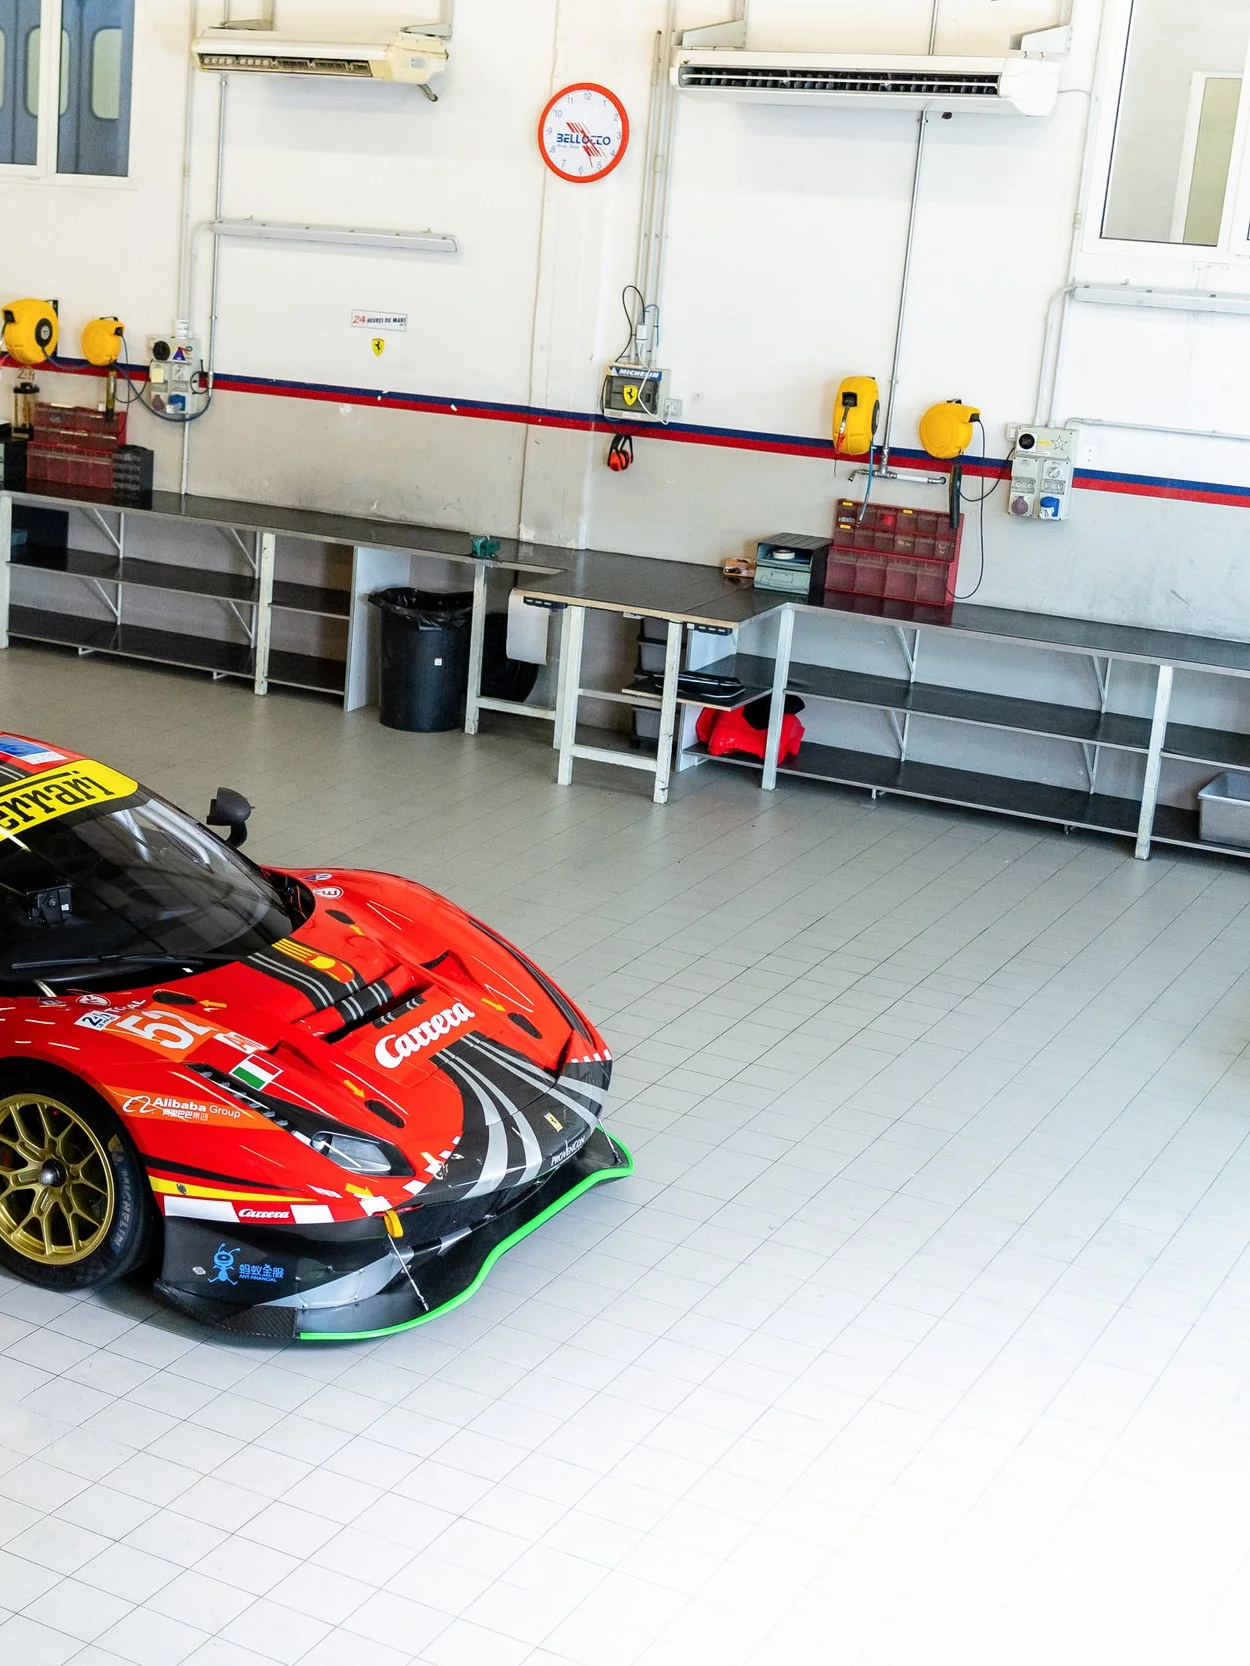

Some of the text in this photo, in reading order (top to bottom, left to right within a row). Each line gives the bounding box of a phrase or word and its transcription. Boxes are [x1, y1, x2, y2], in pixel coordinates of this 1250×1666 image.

[568, 95, 573, 104] 11
[353, 315, 366, 324] 24
[115, 1010, 219, 1050] 52
[375, 1002, 476, 1069] Carrera
[153, 1098, 240, 1119] Alibaba Group
[115, 1170, 132, 1247] MICHELIN
[238, 1208, 290, 1218] Carrera
[239, 1263, 284, 1278] 蚂蚁金服
